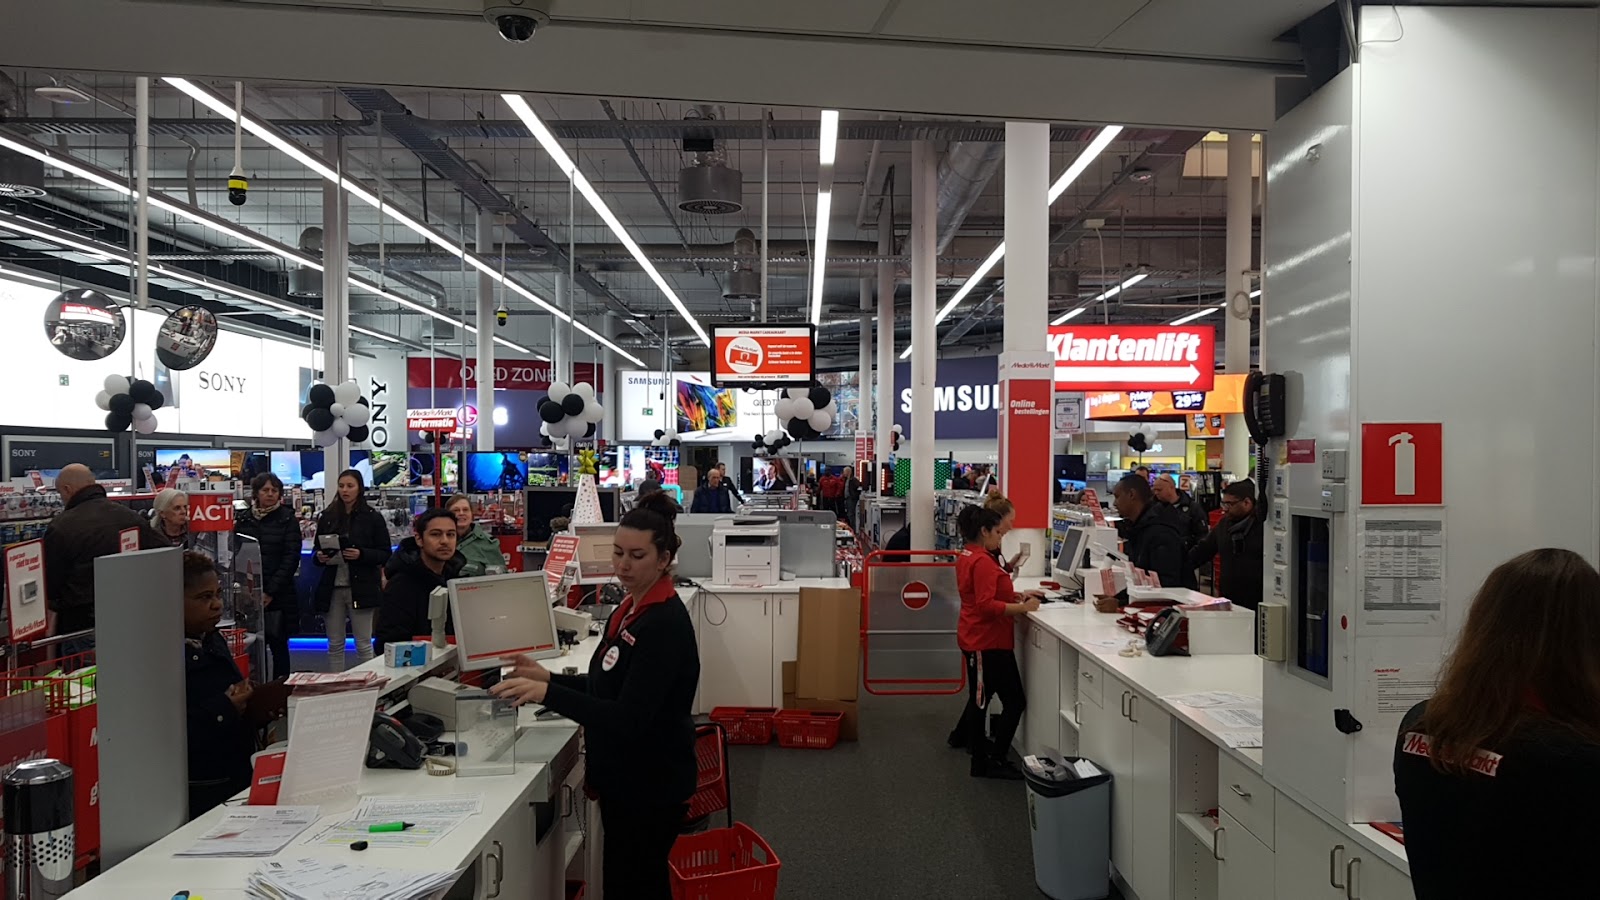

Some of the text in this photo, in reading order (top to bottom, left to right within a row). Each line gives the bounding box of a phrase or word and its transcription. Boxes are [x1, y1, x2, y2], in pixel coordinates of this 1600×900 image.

[1046, 332, 1201, 361] Klantenlift
[199, 371, 246, 393] SONY
[628, 377, 670, 386] SAMSUNG
[753, 399, 771, 407] QLED
[1010, 400, 1036, 408] Online
[372, 377, 387, 448] ONY
[1014, 408, 1050, 416] bestellingen
[409, 418, 454, 428] Informatie
[12, 449, 36, 457] SONY
